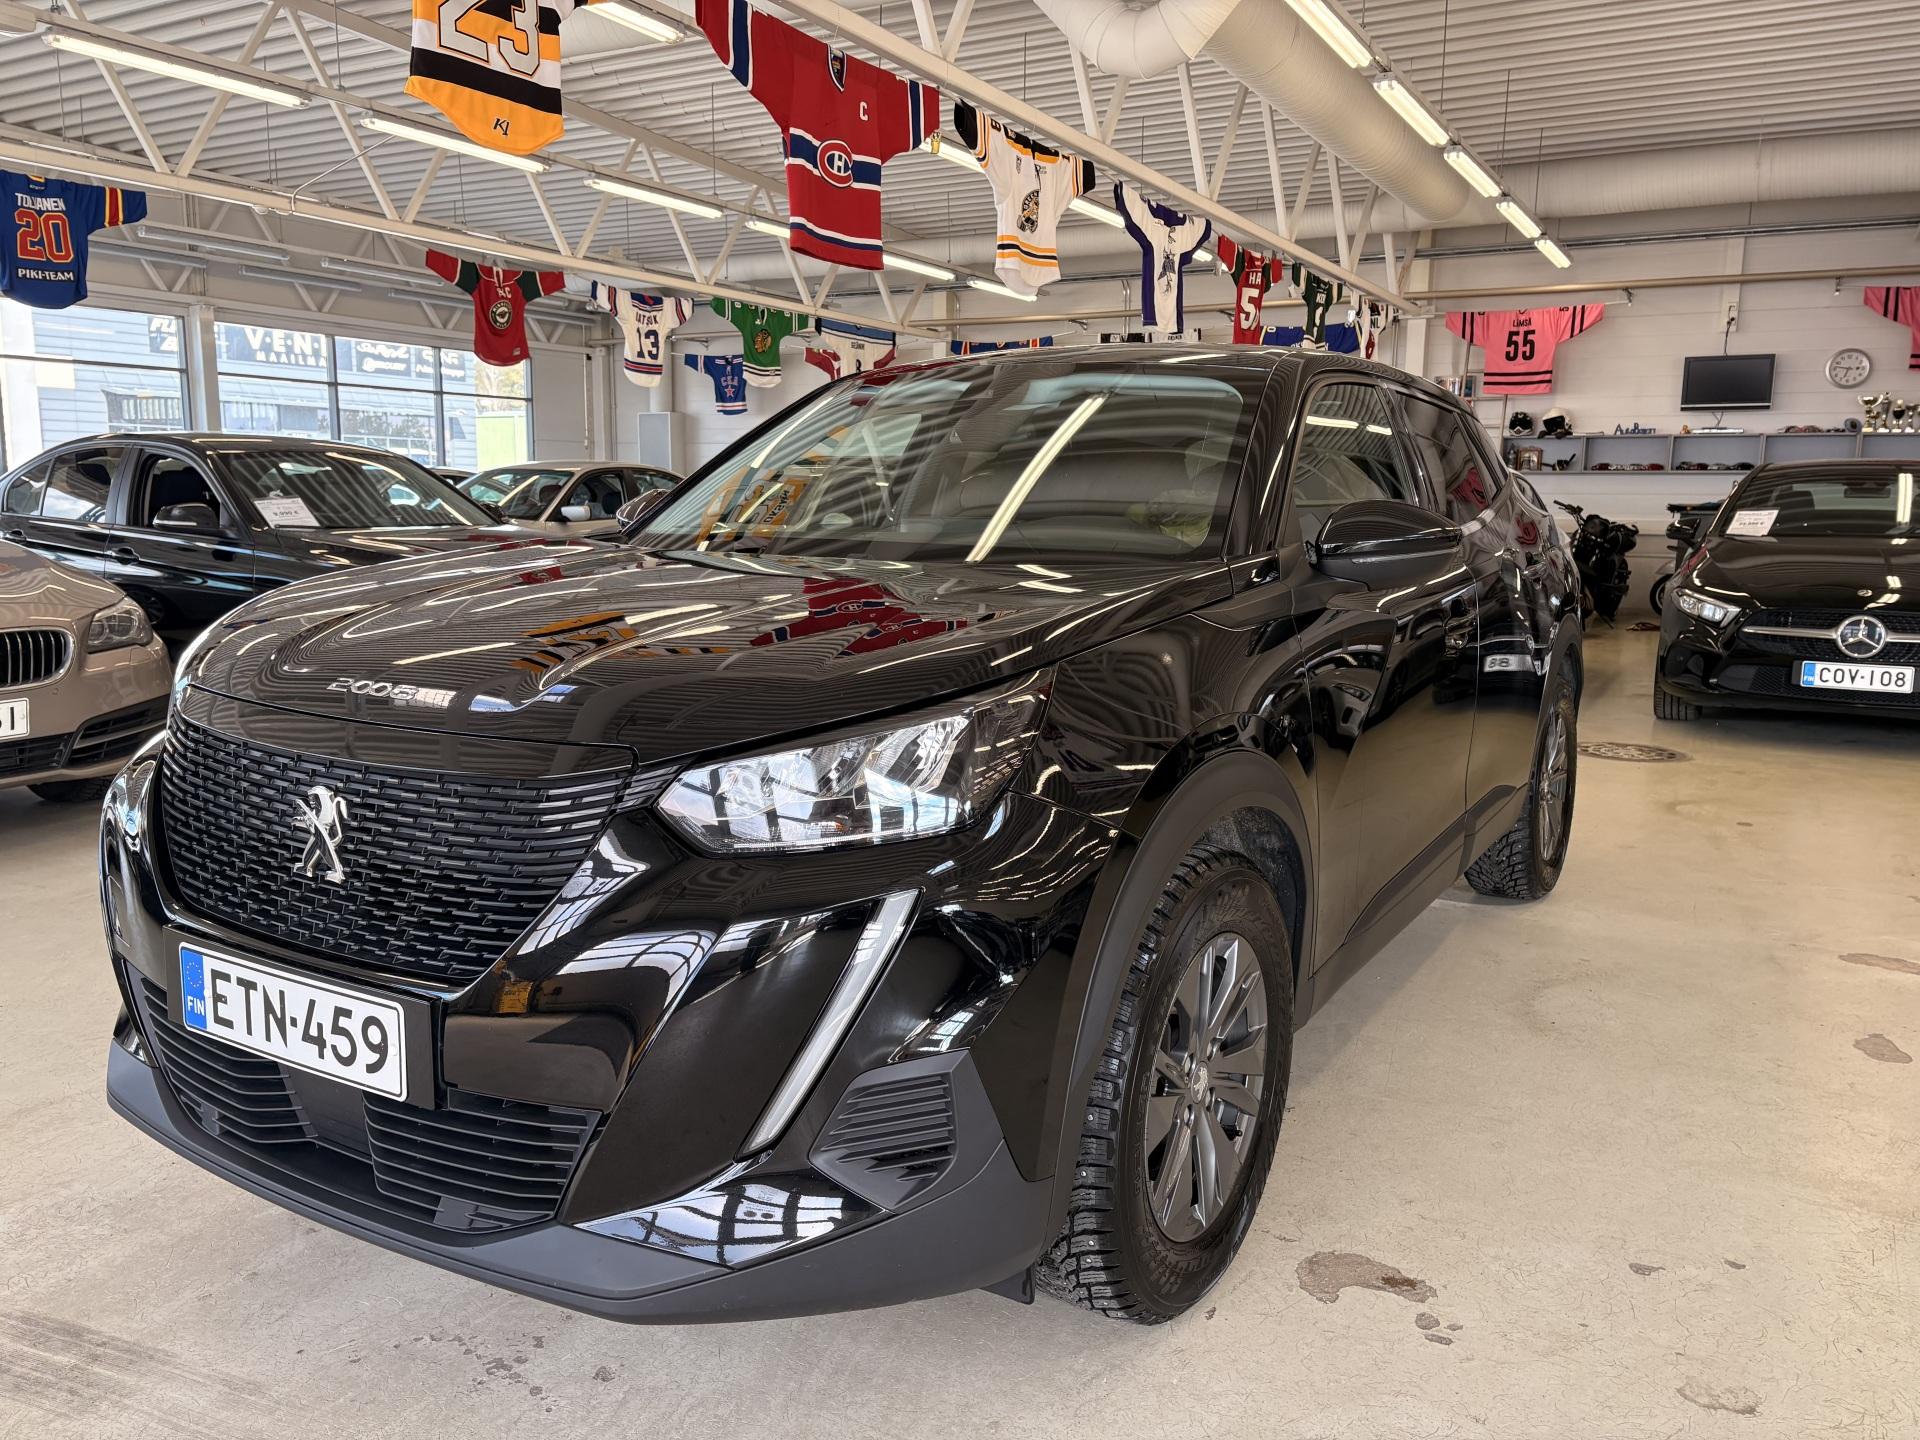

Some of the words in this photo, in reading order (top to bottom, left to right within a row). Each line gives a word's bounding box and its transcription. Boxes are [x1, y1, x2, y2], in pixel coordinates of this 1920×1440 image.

[15, 208, 74, 263] 20
[18, 268, 74, 281] PIKI-TEAM
[636, 327, 659, 360] 13
[1505, 329, 1536, 361] 55
[1820, 667, 1906, 687] COV-108
[187, 995, 205, 1017] FIN
[210, 968, 389, 1074] ETN-459
